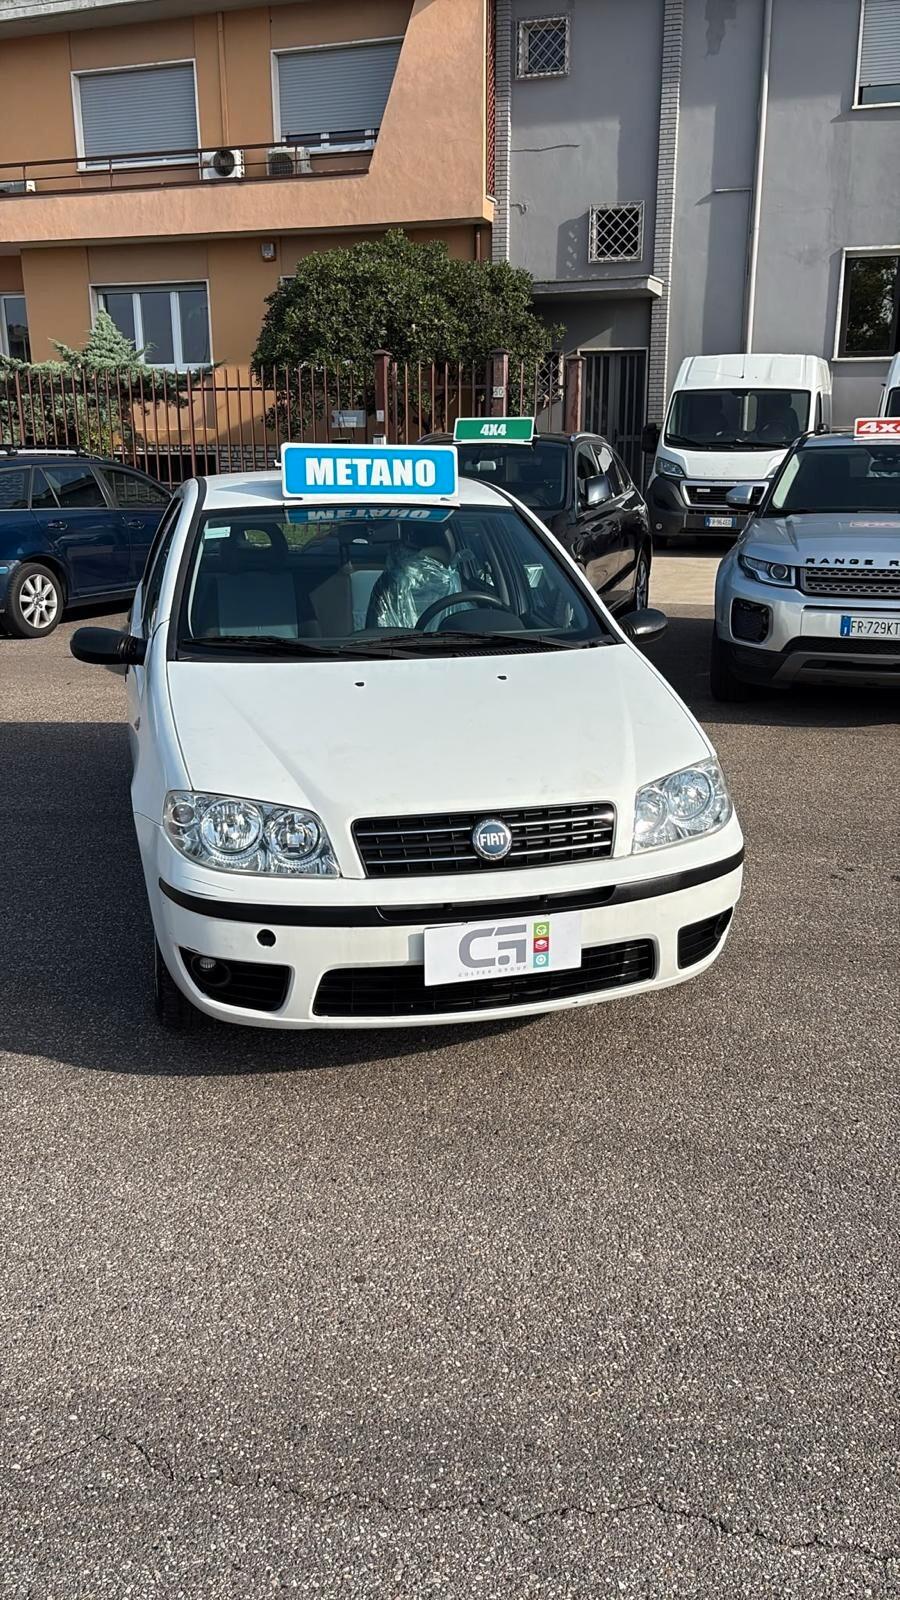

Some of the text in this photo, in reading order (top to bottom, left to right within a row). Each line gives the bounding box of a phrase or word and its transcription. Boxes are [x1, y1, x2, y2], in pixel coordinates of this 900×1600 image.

[859, 422, 900, 433] 4x
[305, 457, 436, 487] METANO
[805, 558, 874, 566] RANGE
[480, 832, 505, 846] FIAT
[498, 965, 527, 973] GROUP
